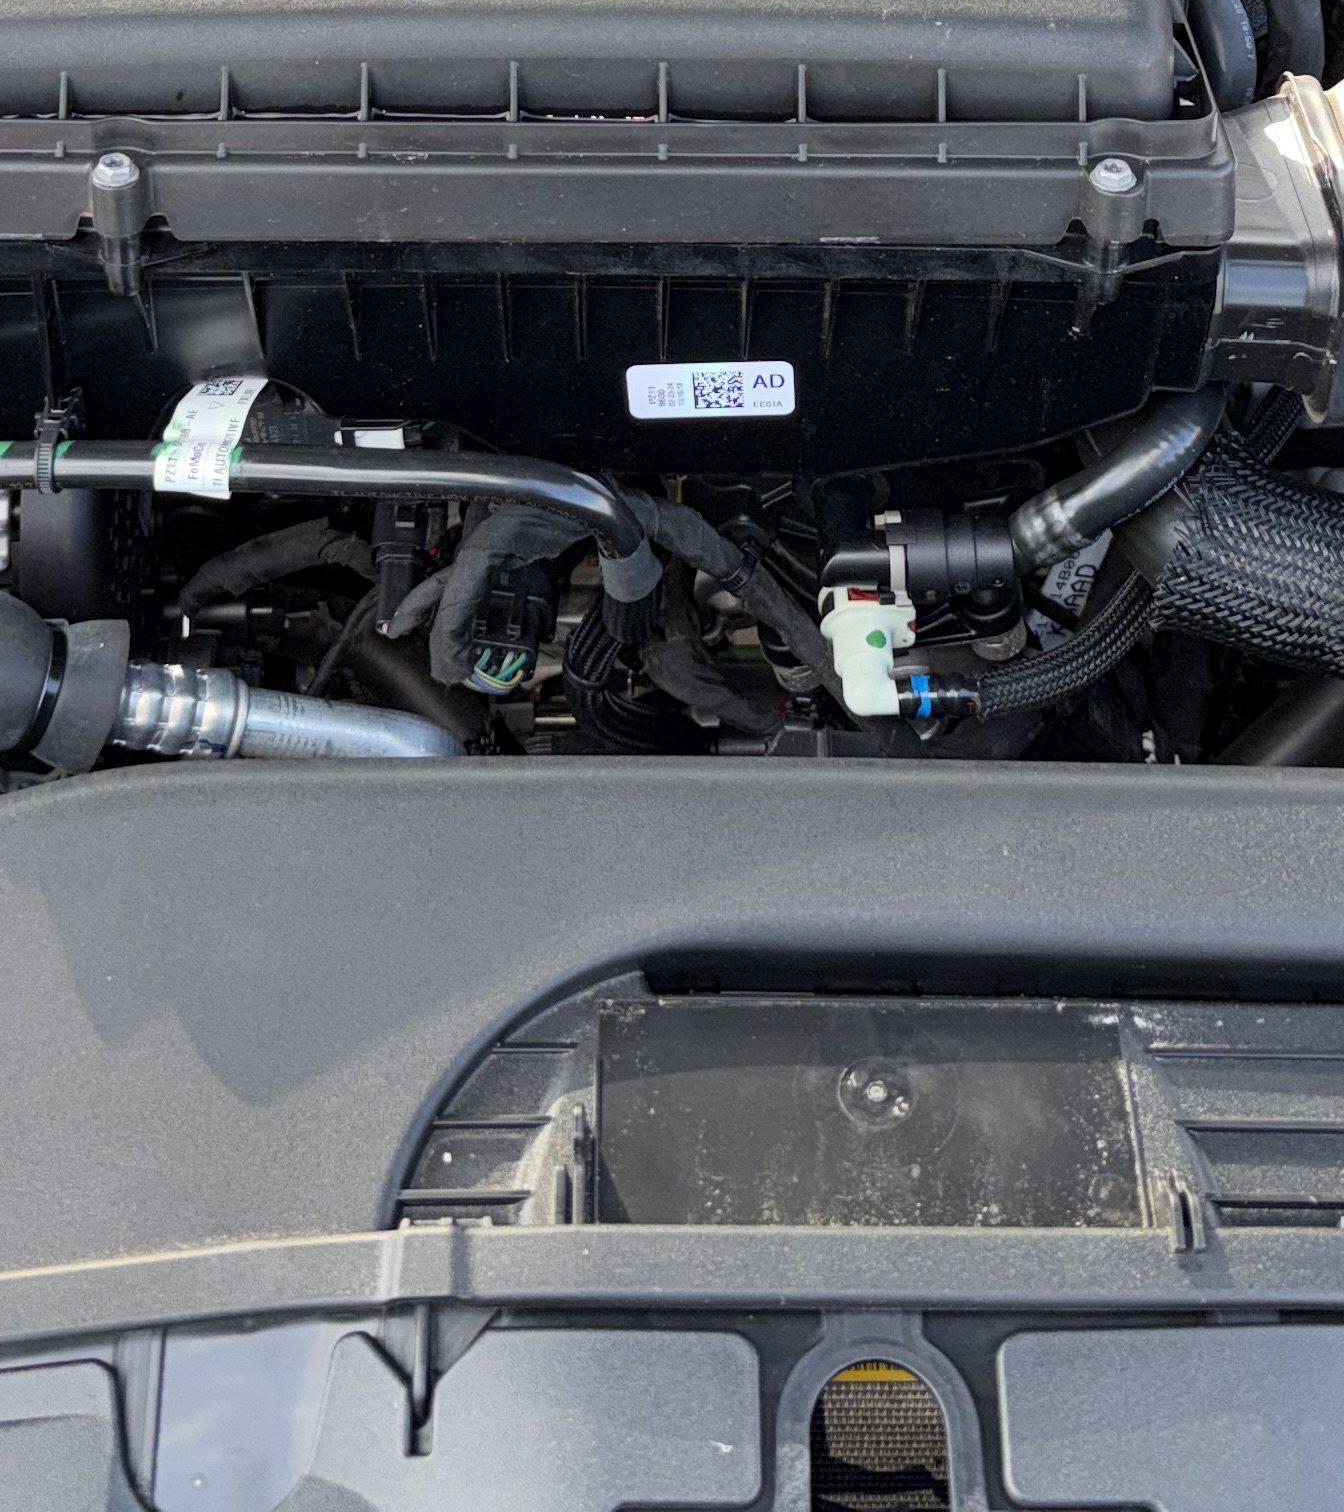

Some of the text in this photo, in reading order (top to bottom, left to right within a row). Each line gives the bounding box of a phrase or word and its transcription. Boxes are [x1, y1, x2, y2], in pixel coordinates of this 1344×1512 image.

[647, 385, 657, 406] PZ11
[751, 373, 786, 390] AD
[187, 441, 207, 481] FoMoCo
[215, 416, 242, 477] AUTOMOTIVE
